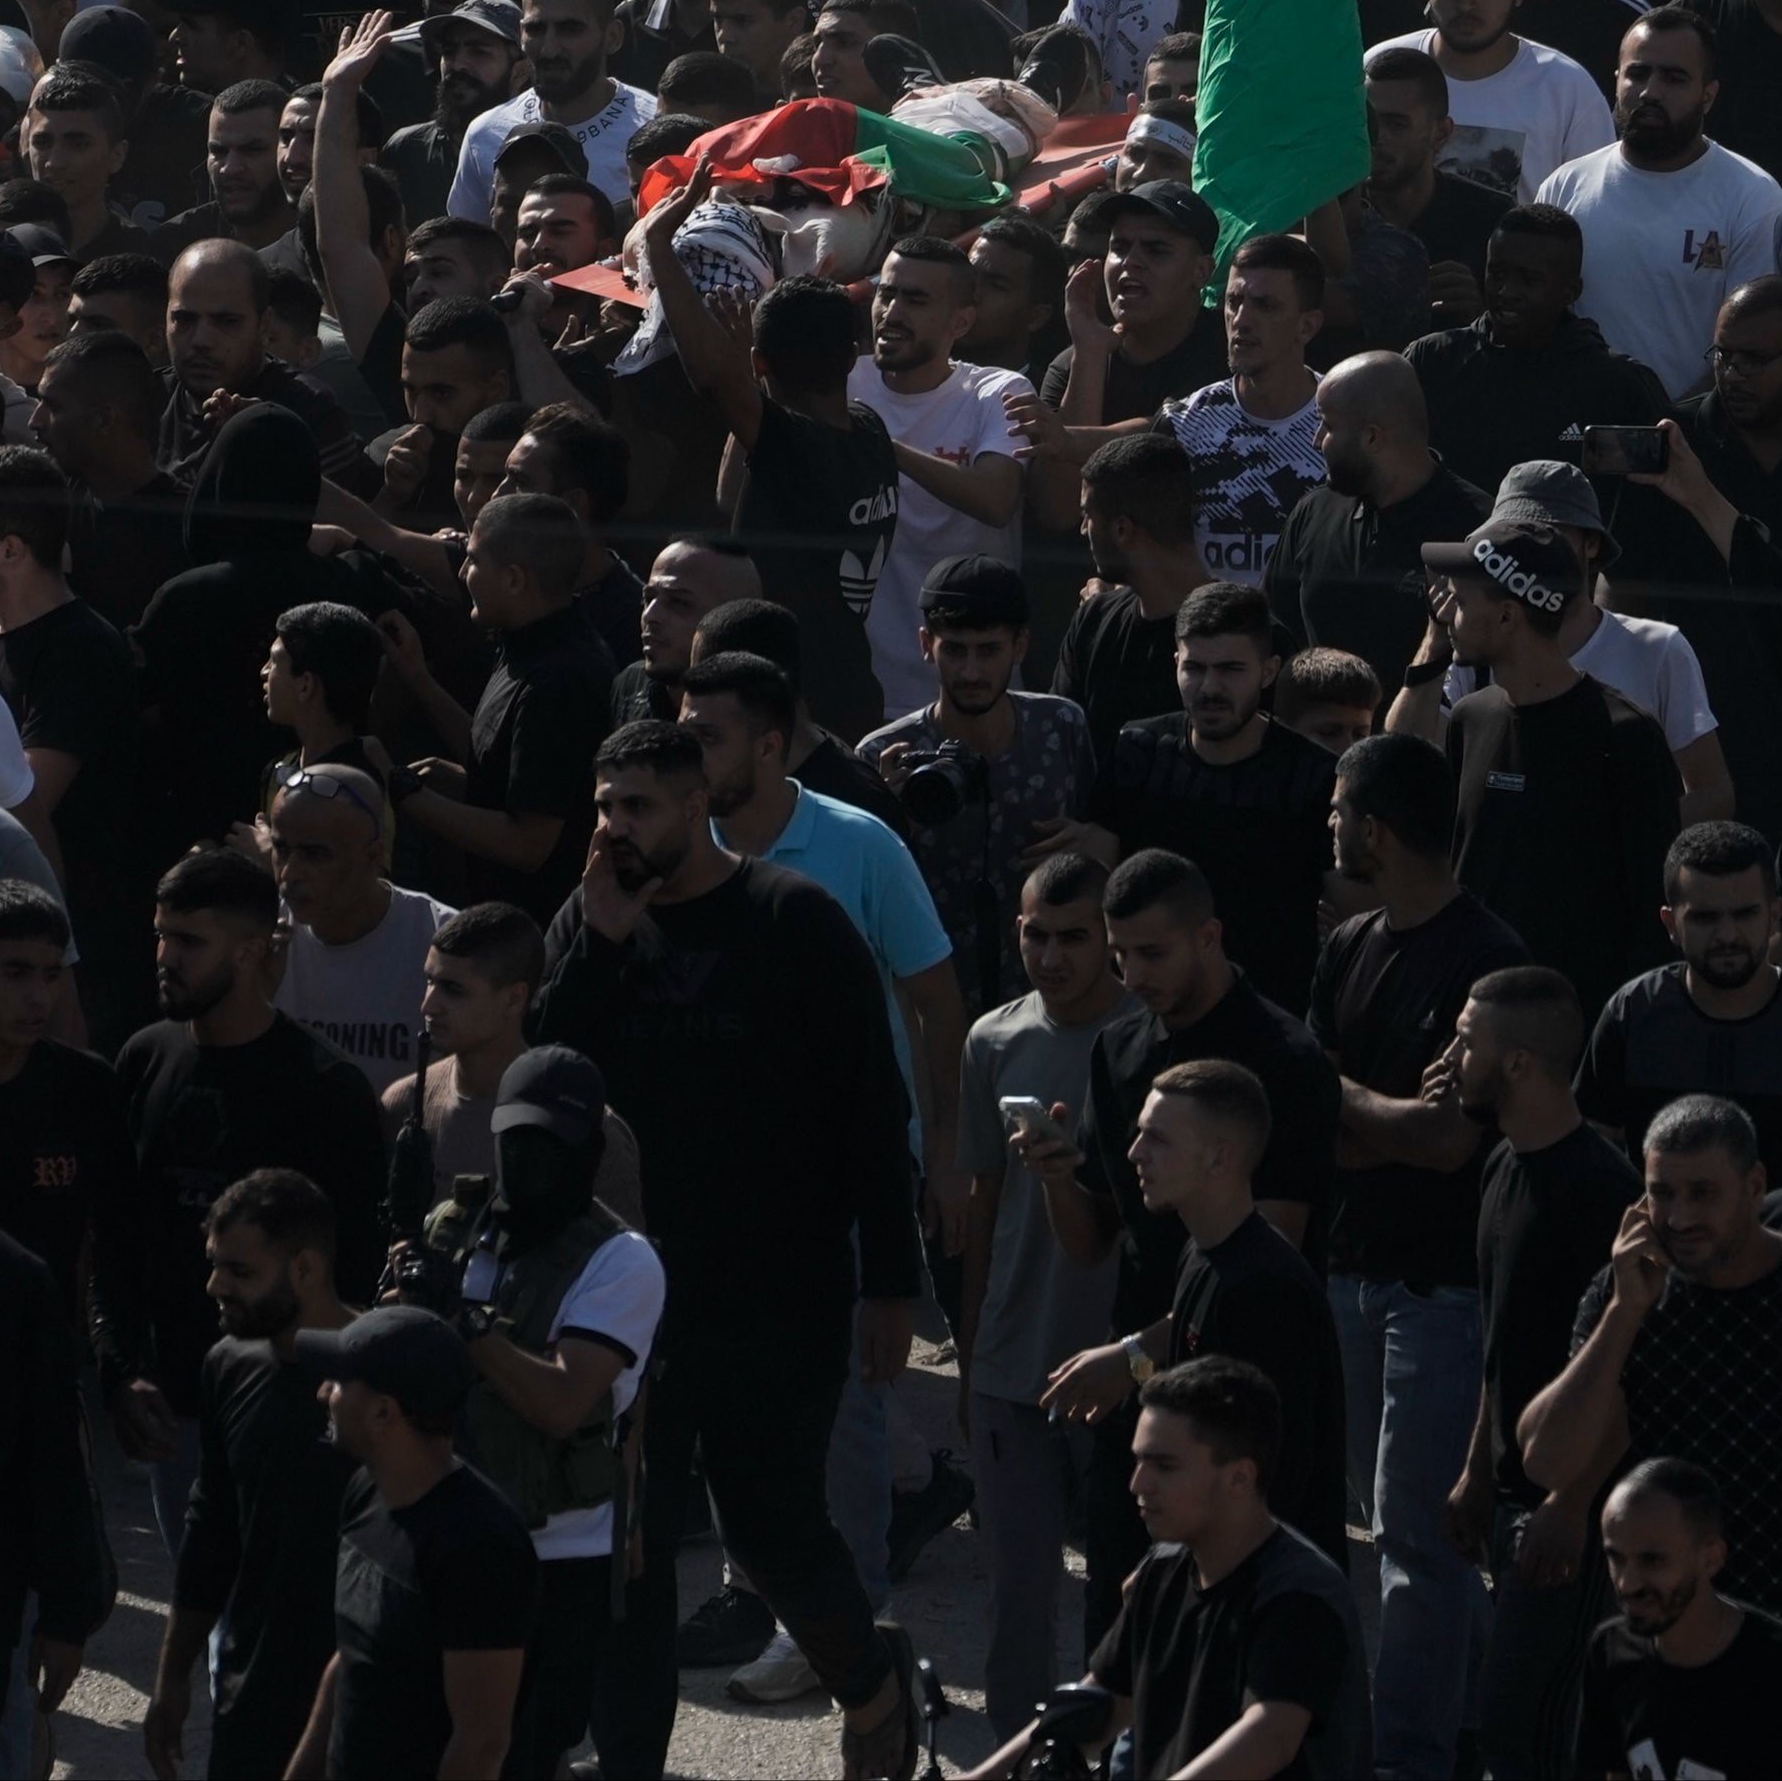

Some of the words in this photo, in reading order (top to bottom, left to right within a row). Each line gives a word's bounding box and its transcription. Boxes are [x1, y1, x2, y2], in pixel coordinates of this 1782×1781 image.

[319, 15, 359, 35] VERS
[579, 96, 629, 144] BBANA
[1205, 527, 1282, 571] adi
[1473, 539, 1565, 613] adidas
